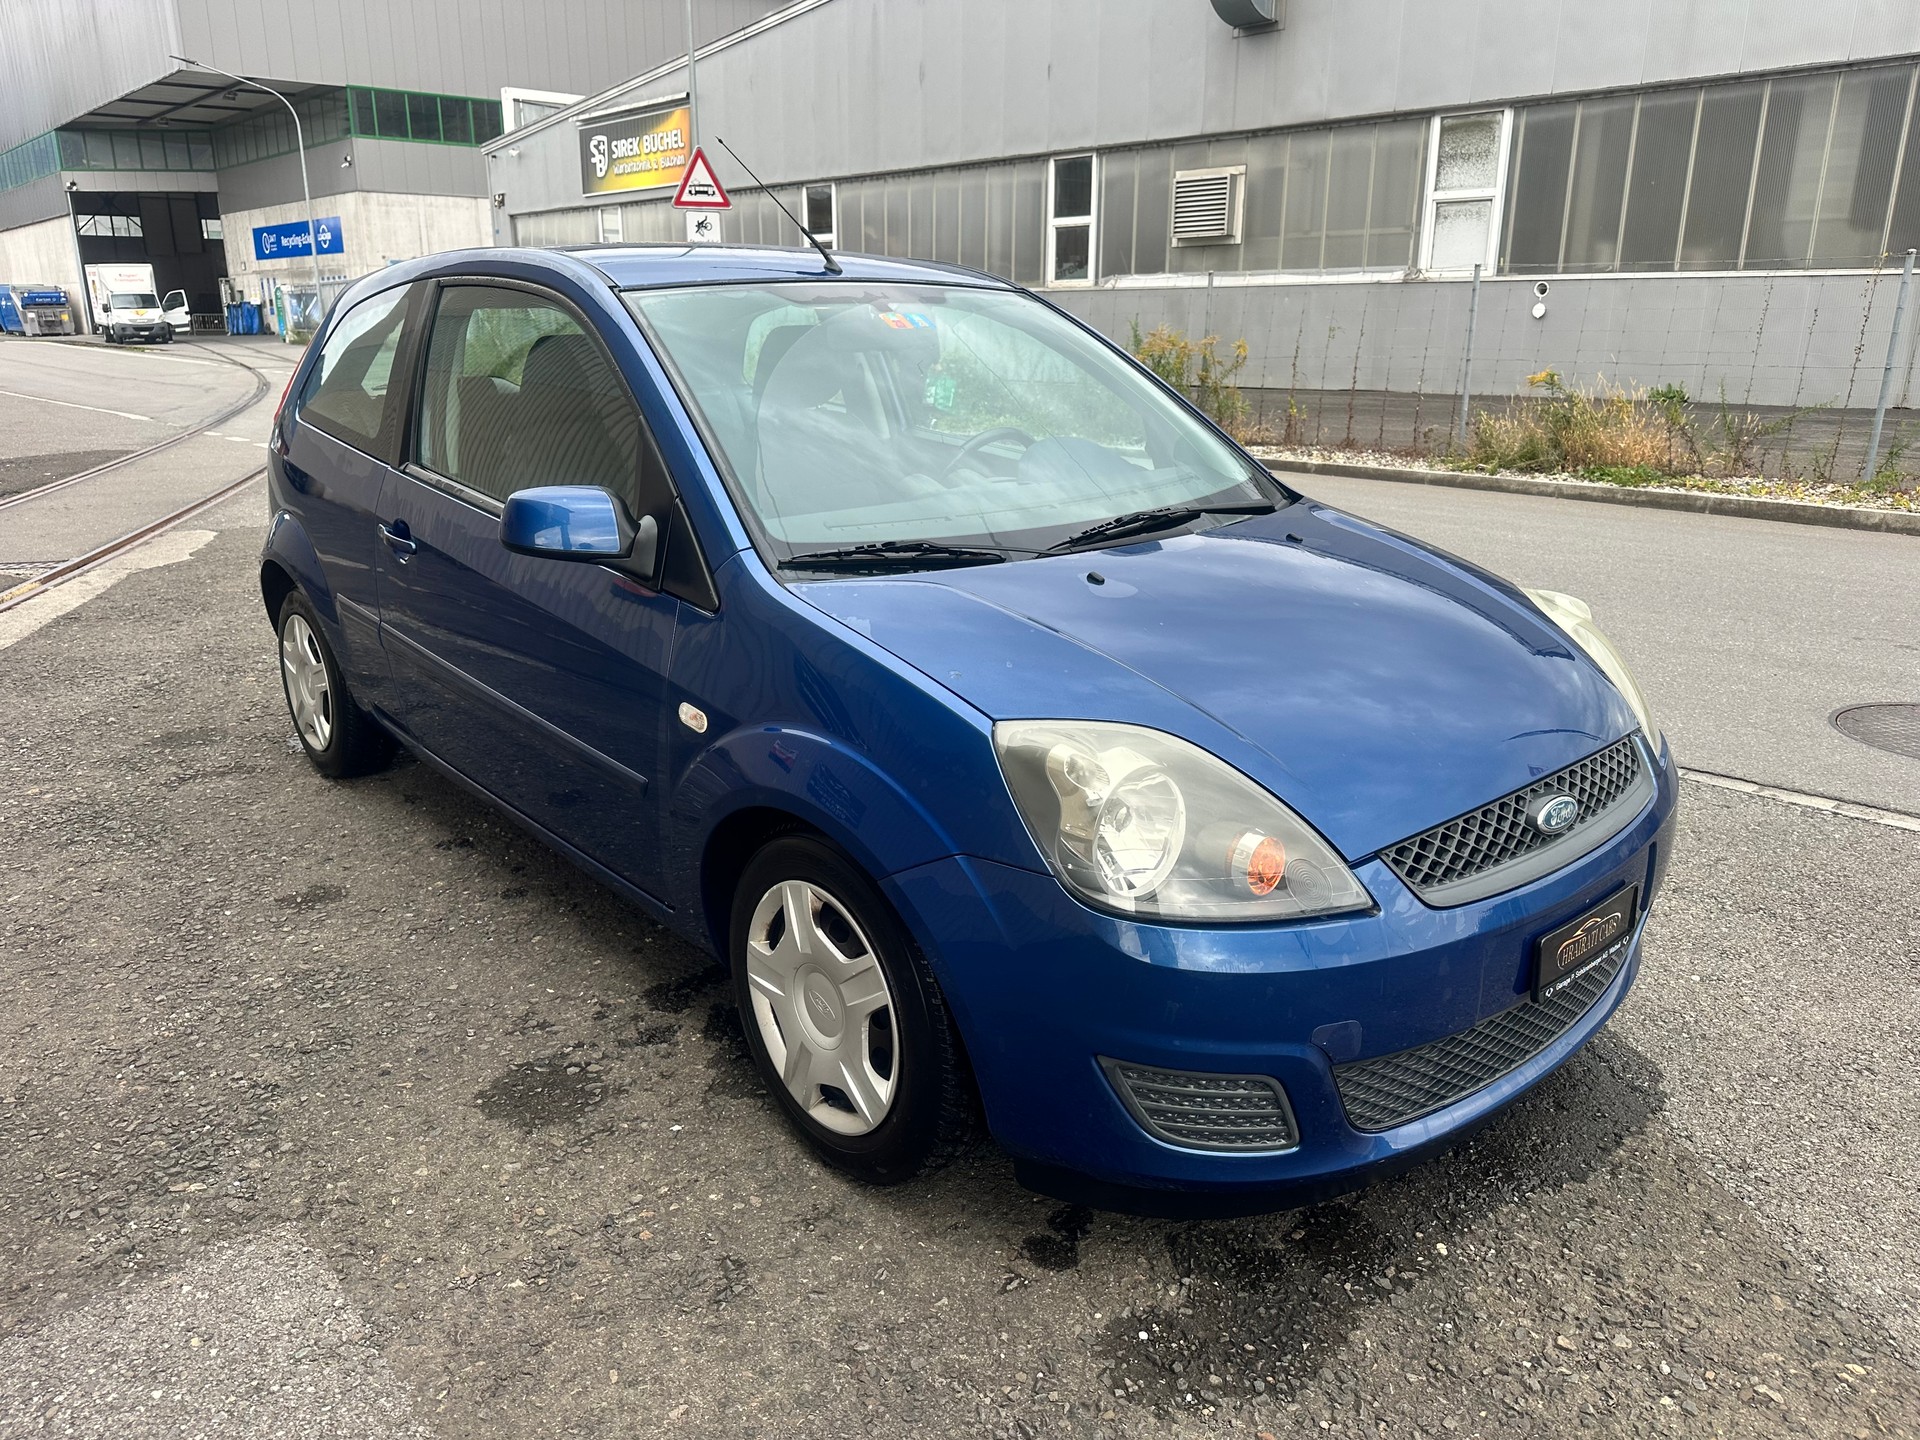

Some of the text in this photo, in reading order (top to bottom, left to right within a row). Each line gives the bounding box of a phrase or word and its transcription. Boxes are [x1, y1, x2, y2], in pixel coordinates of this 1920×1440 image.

[611, 136, 640, 159] SIREK
[1550, 803, 1574, 826] Ford
[1600, 916, 1617, 942] CARS
